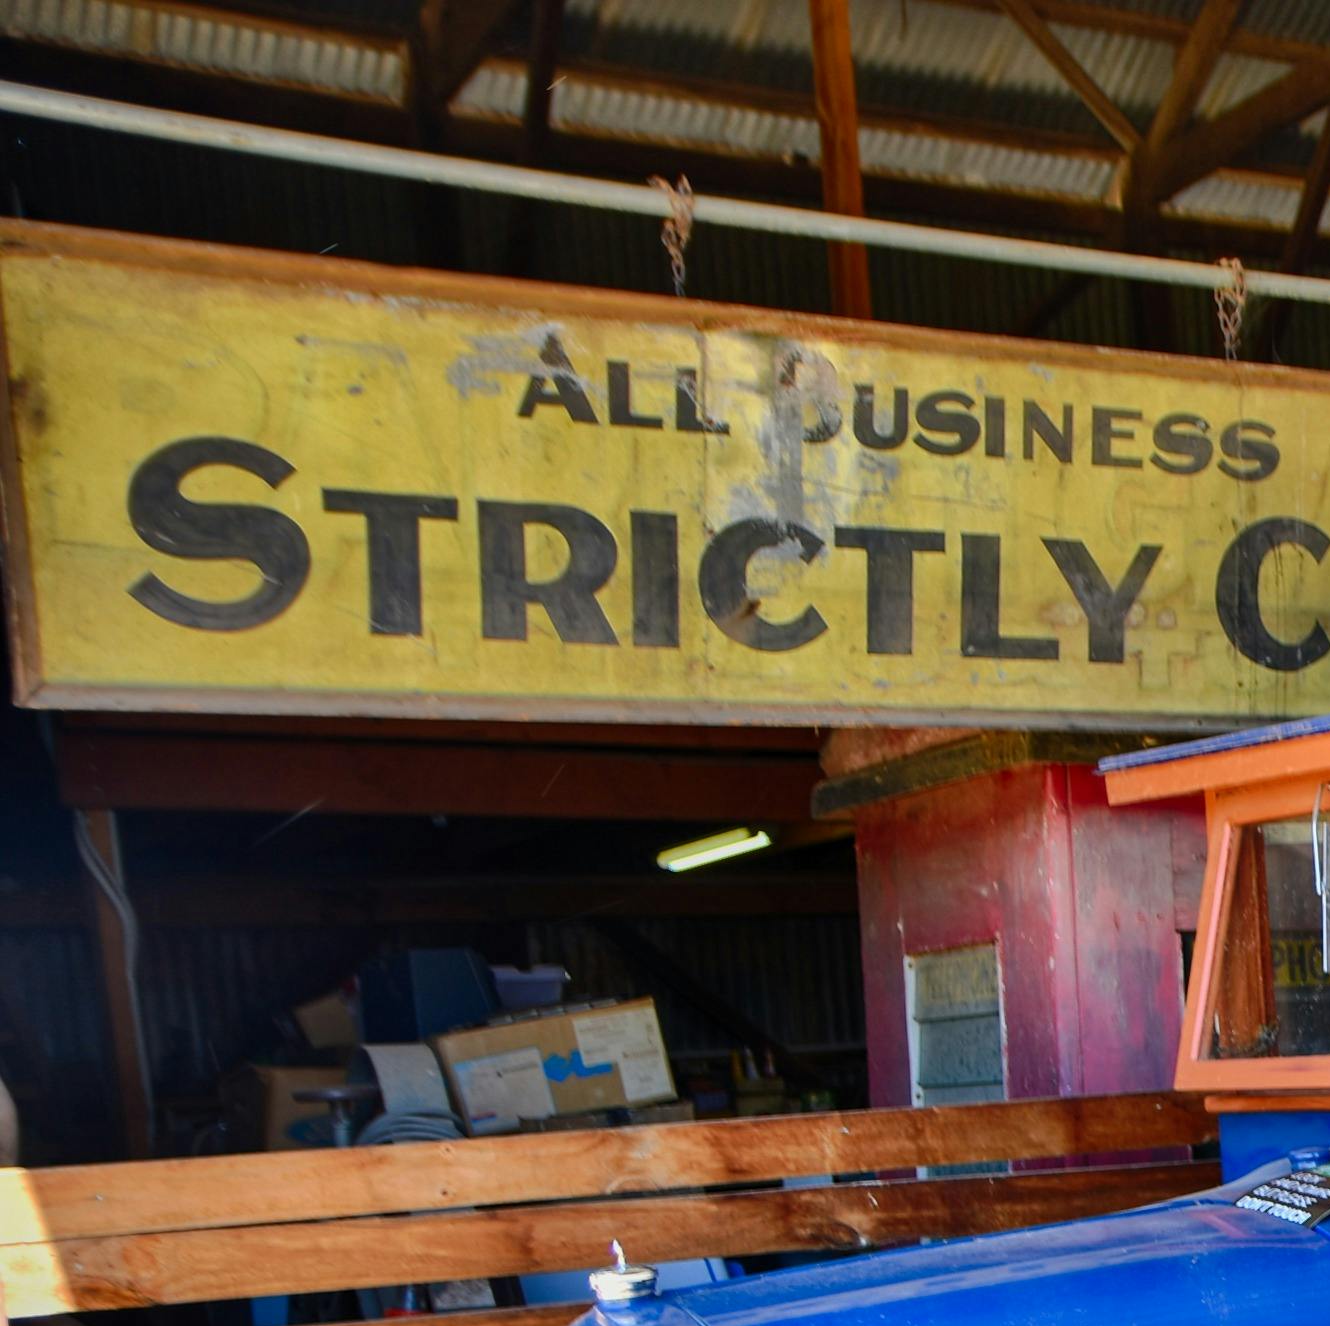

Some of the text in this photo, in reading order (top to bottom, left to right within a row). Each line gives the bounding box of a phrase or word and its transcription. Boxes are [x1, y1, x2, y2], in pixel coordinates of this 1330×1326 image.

[517, 330, 1281, 482] ALL BUSINESS
[127, 435, 1164, 663] STRICTLY
